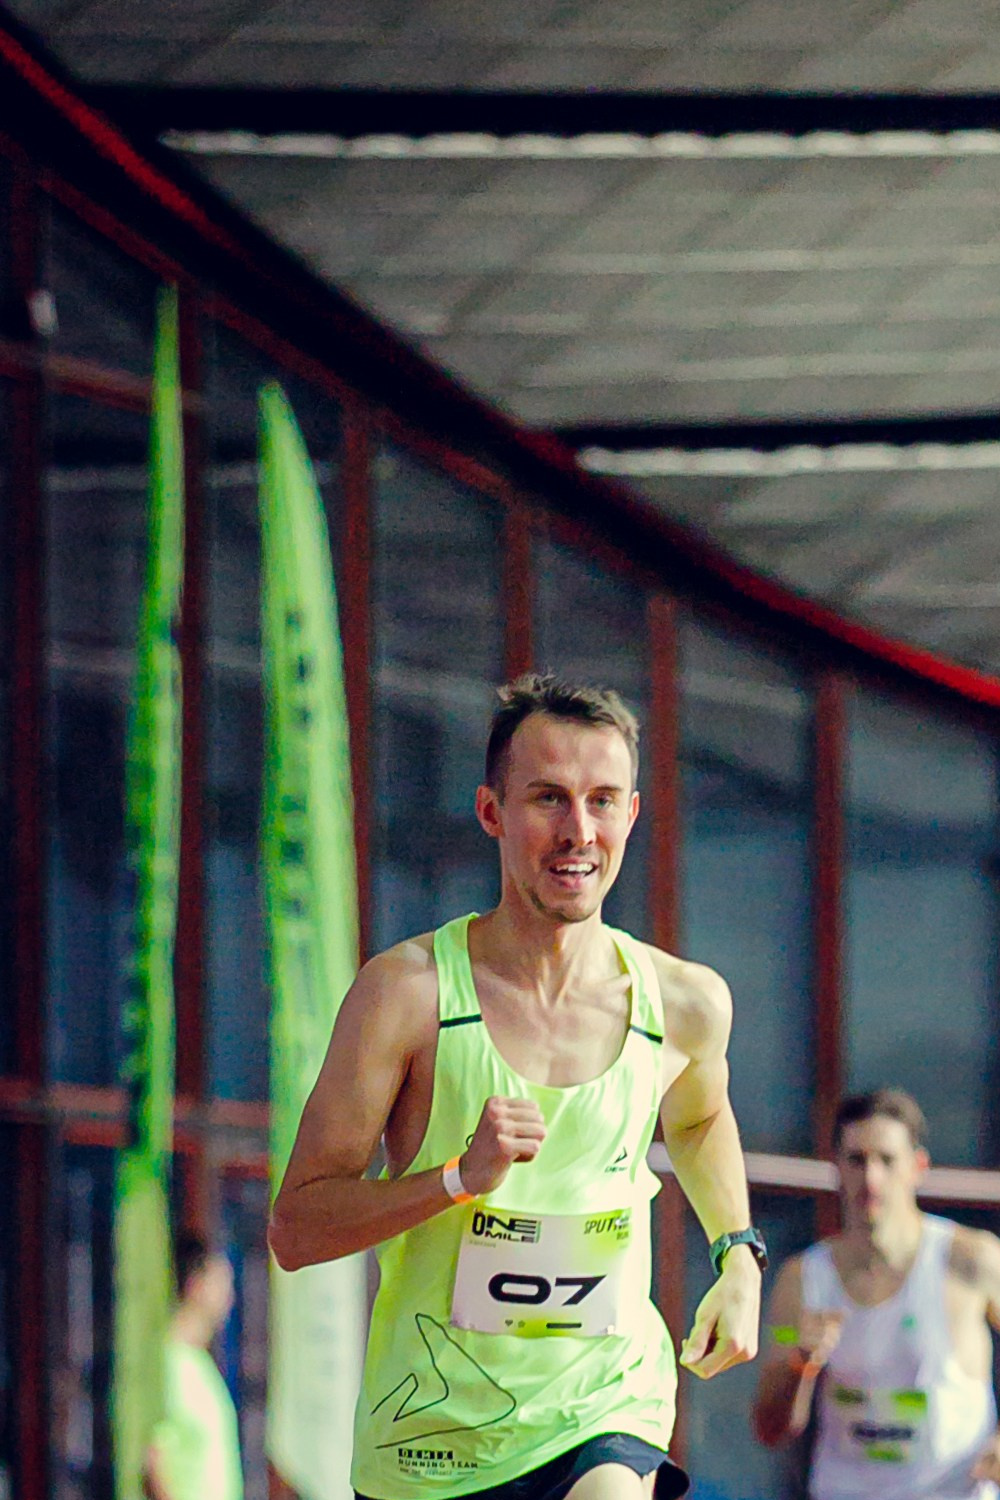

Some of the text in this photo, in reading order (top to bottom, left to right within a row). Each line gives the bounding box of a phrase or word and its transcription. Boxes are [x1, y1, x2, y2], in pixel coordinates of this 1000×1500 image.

[472, 1211, 537, 1236] ONE
[583, 1216, 630, 1235] SPUT
[488, 1272, 608, 1307] 07
[398, 1458, 478, 1469] RUNNING TEAM
